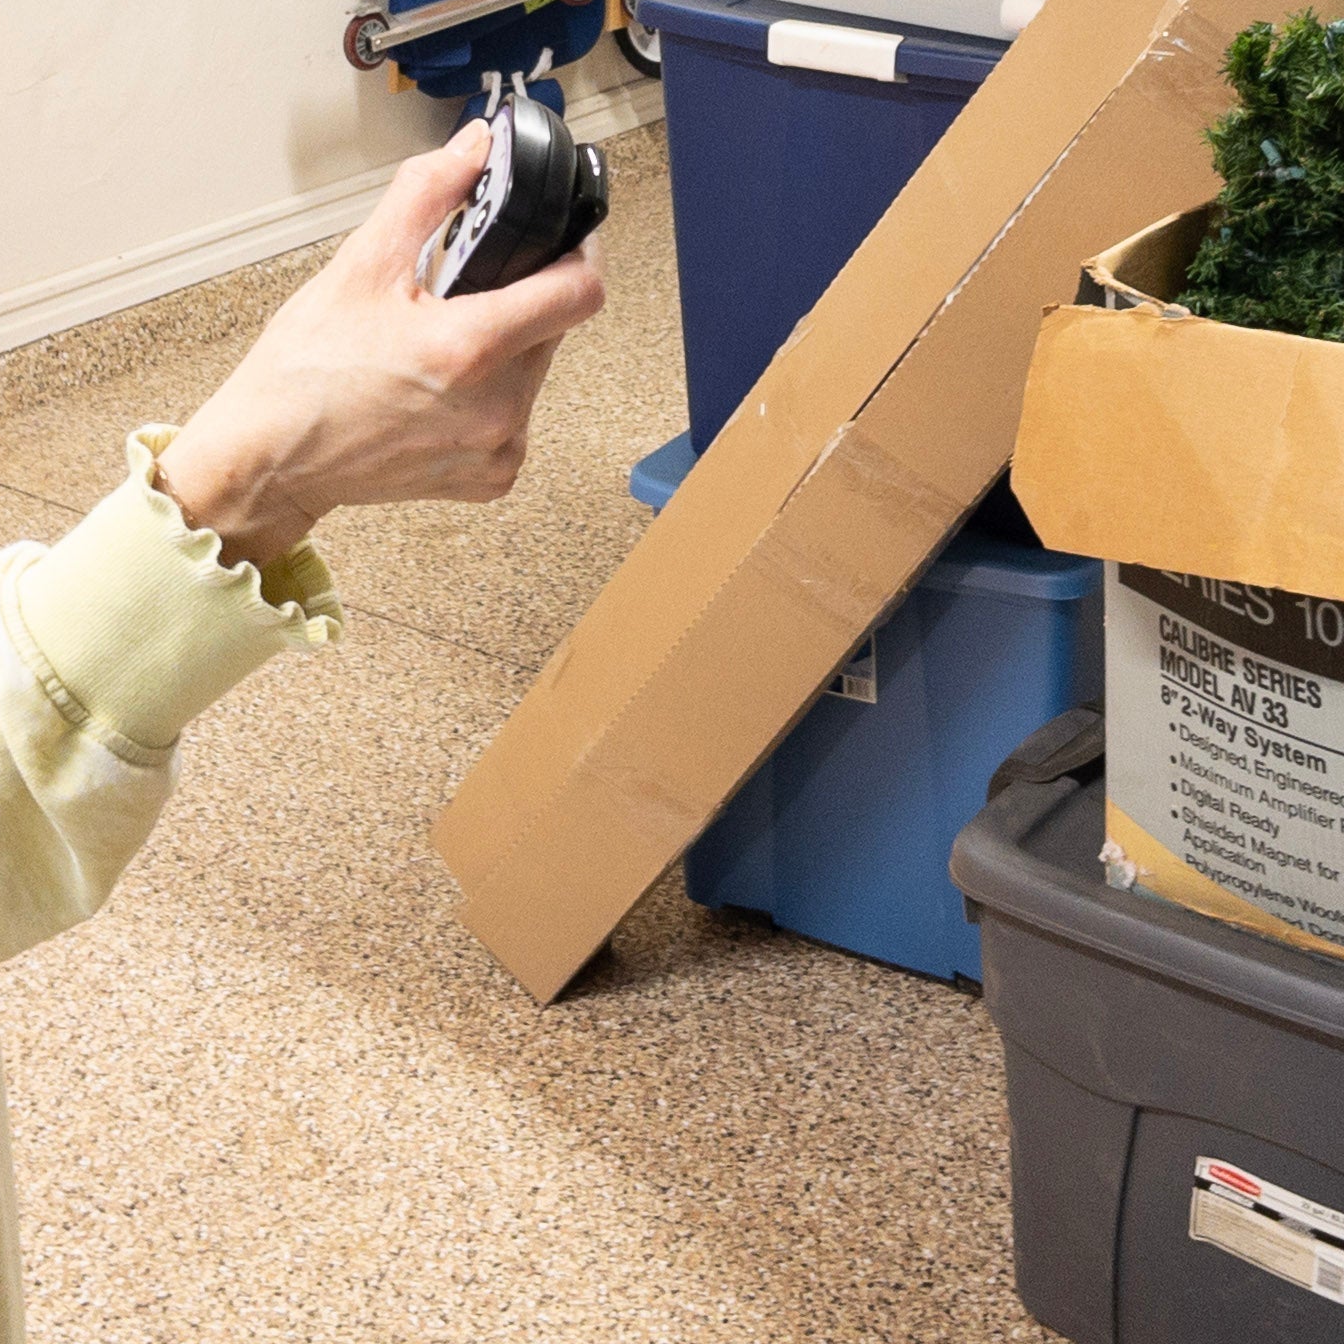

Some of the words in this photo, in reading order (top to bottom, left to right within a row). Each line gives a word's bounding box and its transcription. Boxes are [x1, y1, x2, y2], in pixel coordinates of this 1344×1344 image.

[1159, 613, 1236, 676] CALIBRE
[1242, 657, 1322, 709] SERIES
[1159, 645, 1225, 702] MODEL
[1231, 684, 1256, 715] AV
[1262, 697, 1288, 728] 33
[1179, 723, 1251, 774] Designed,
[1181, 696, 1238, 743] 2-Way
[1244, 726, 1327, 774] System
[1180, 752, 1255, 800] Maximum
[1259, 790, 1335, 829] Amplifier
[1181, 779, 1224, 813] Digital
[1229, 802, 1280, 838] Ready
[1182, 807, 1247, 848] Shielded
[1251, 837, 1313, 874] Magnet
[1317, 861, 1340, 882] for
[1183, 828, 1266, 875] Application
